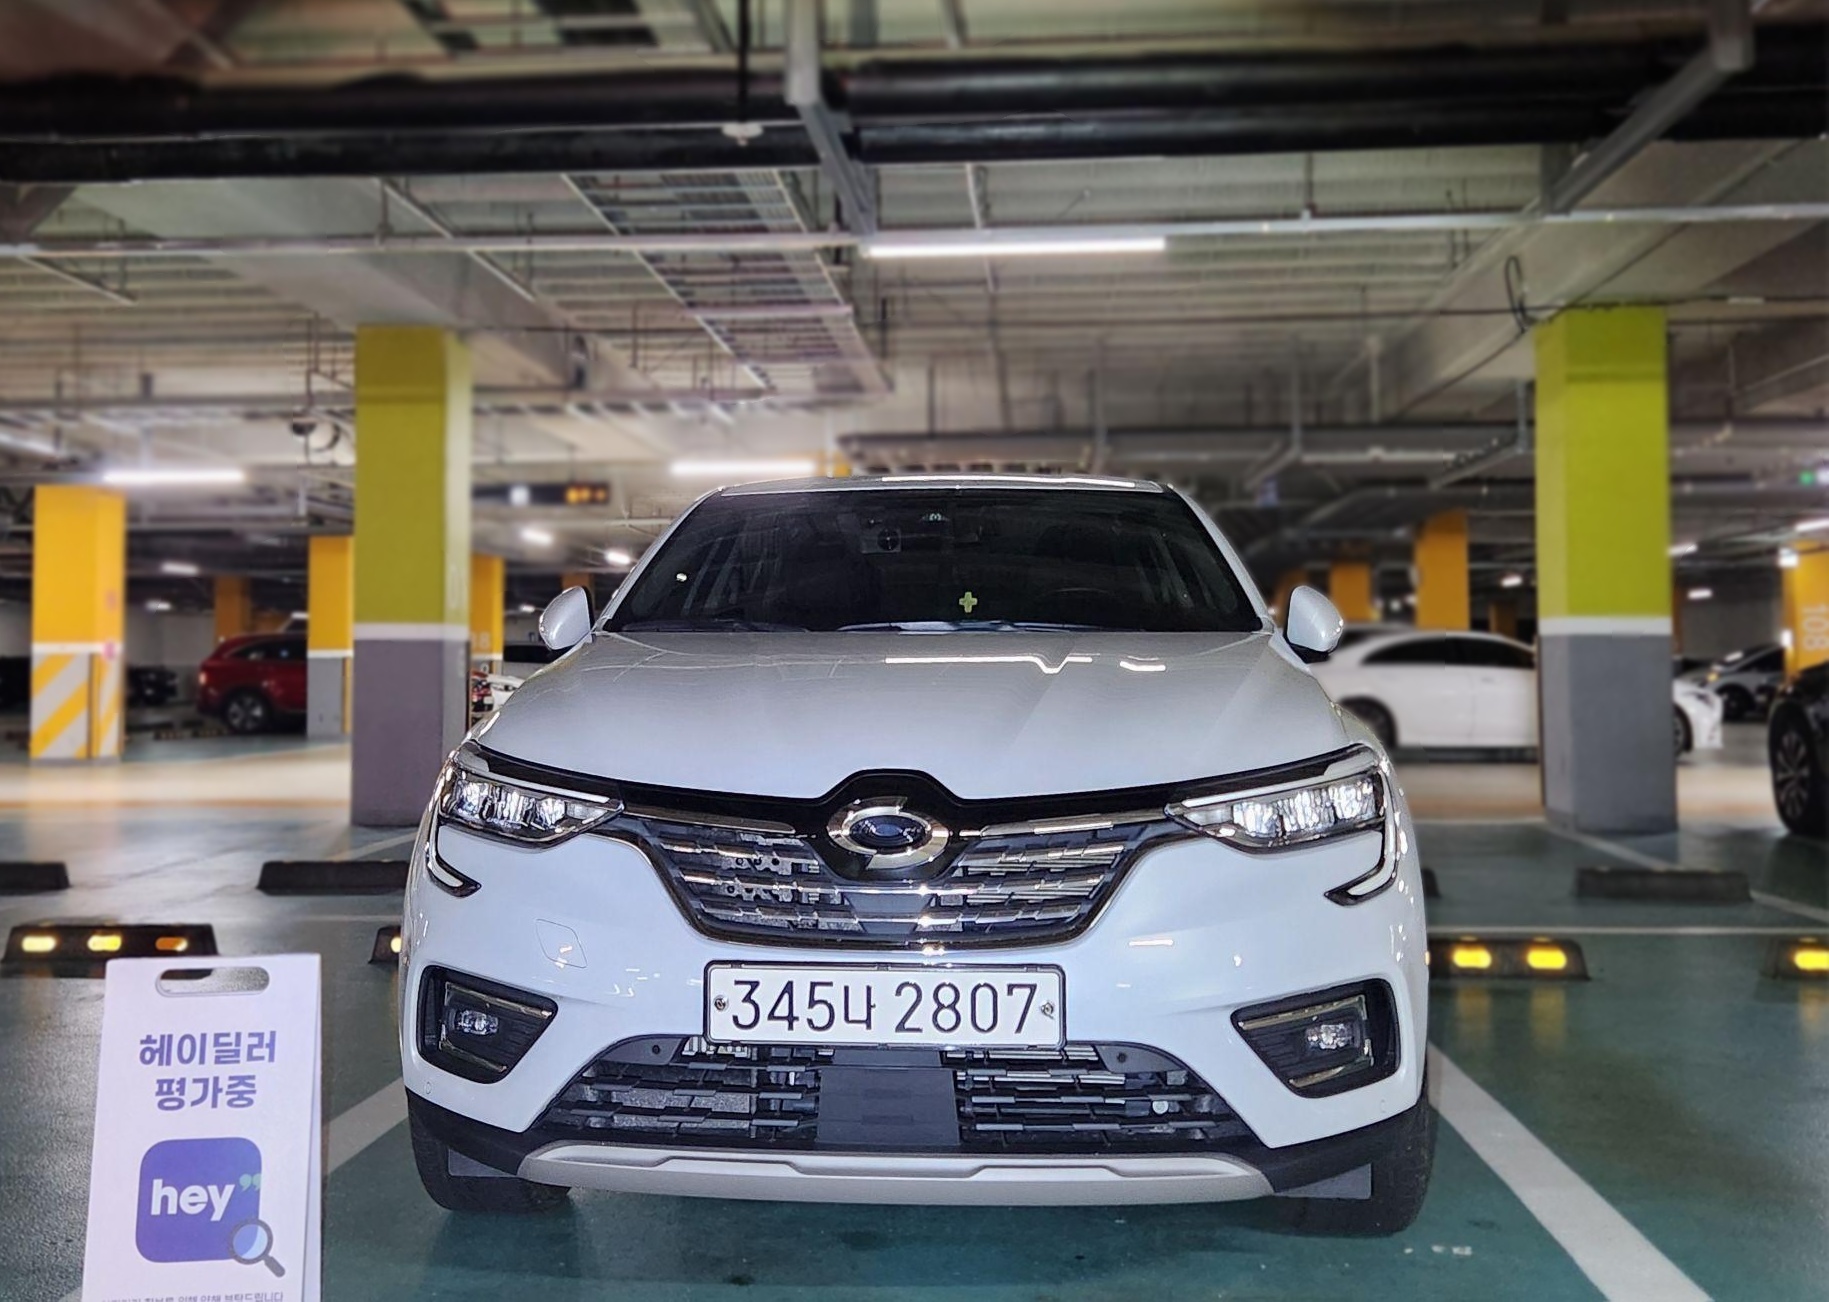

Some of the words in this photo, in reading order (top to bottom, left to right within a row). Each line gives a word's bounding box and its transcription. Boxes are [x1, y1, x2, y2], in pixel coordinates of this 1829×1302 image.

[731, 979, 876, 1032] 345나
[894, 981, 1038, 1034] 2807
[139, 1030, 277, 1067] 헤이딜러
[154, 1074, 257, 1111] 평가중
